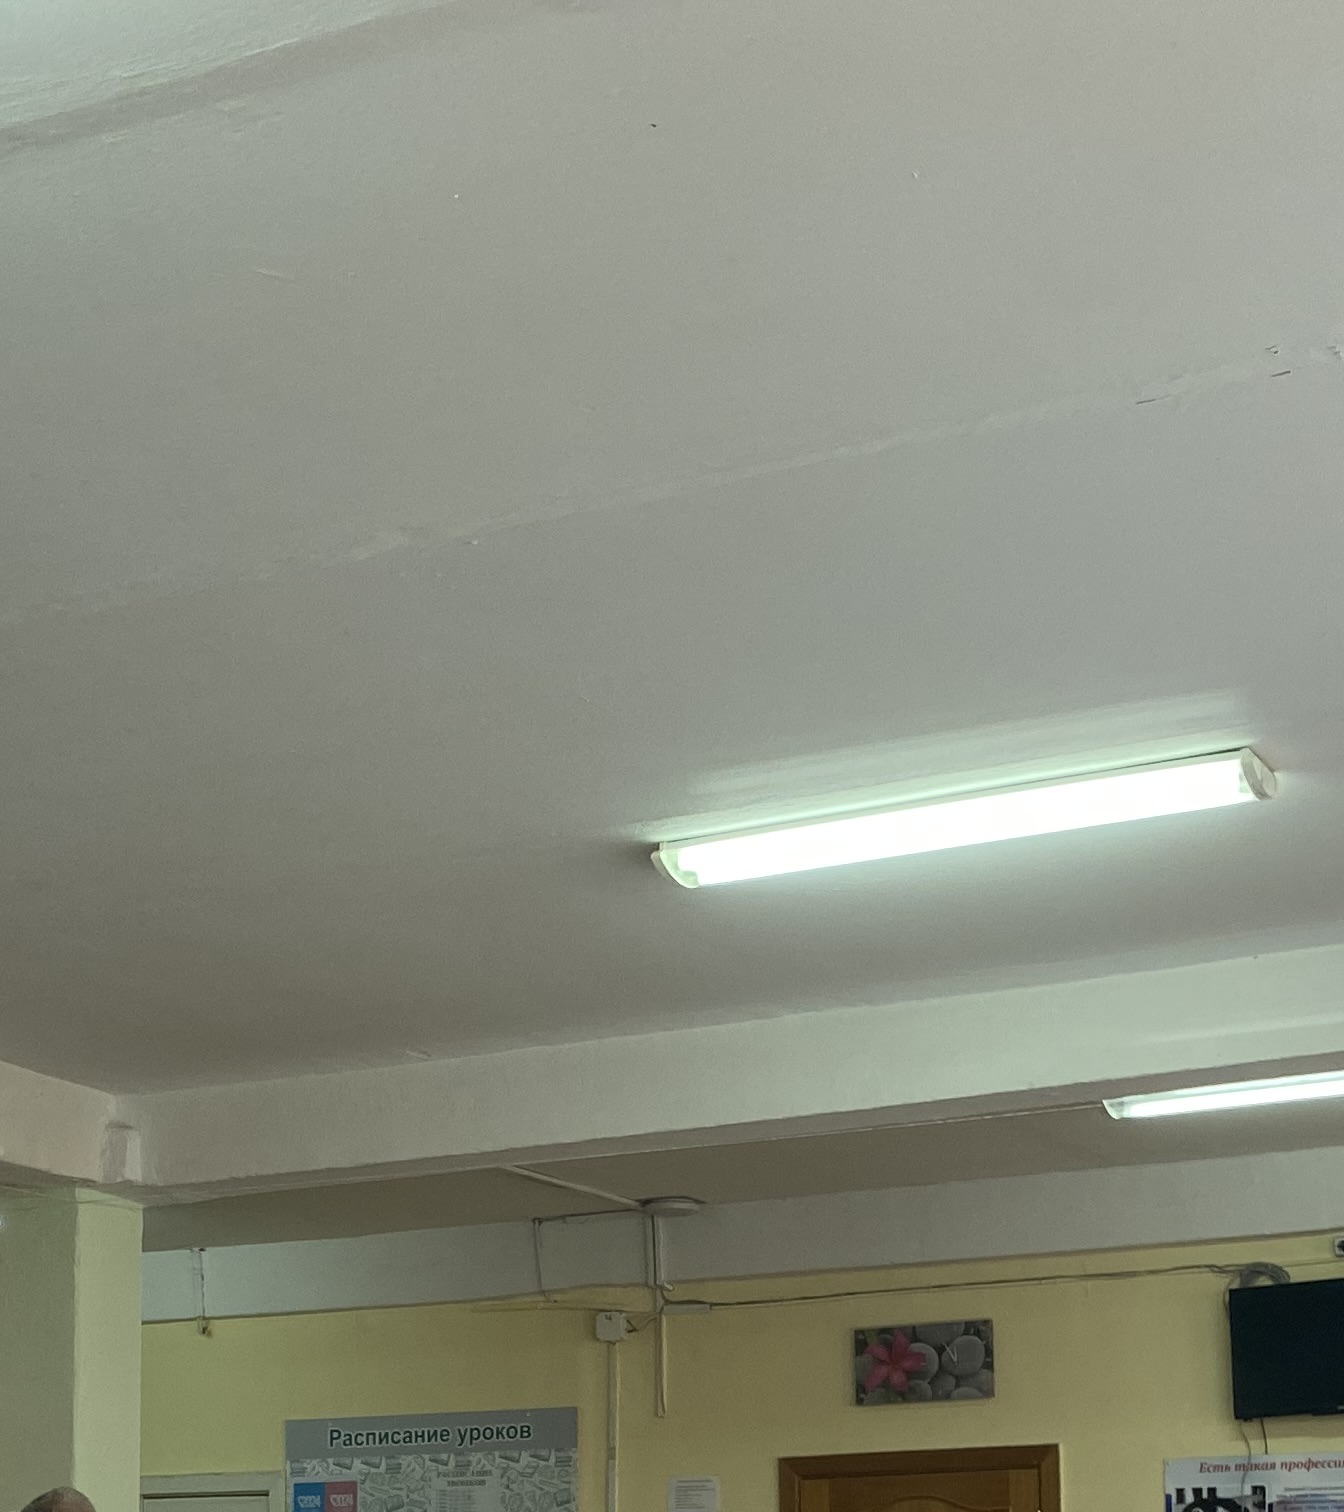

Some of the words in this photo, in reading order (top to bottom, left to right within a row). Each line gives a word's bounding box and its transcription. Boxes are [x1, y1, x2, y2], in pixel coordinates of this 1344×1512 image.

[329, 1426, 450, 1447] Расписание
[457, 1424, 532, 1446] уроков
[1199, 1461, 1231, 1473] Есть
[1235, 1461, 1276, 1472] такая
